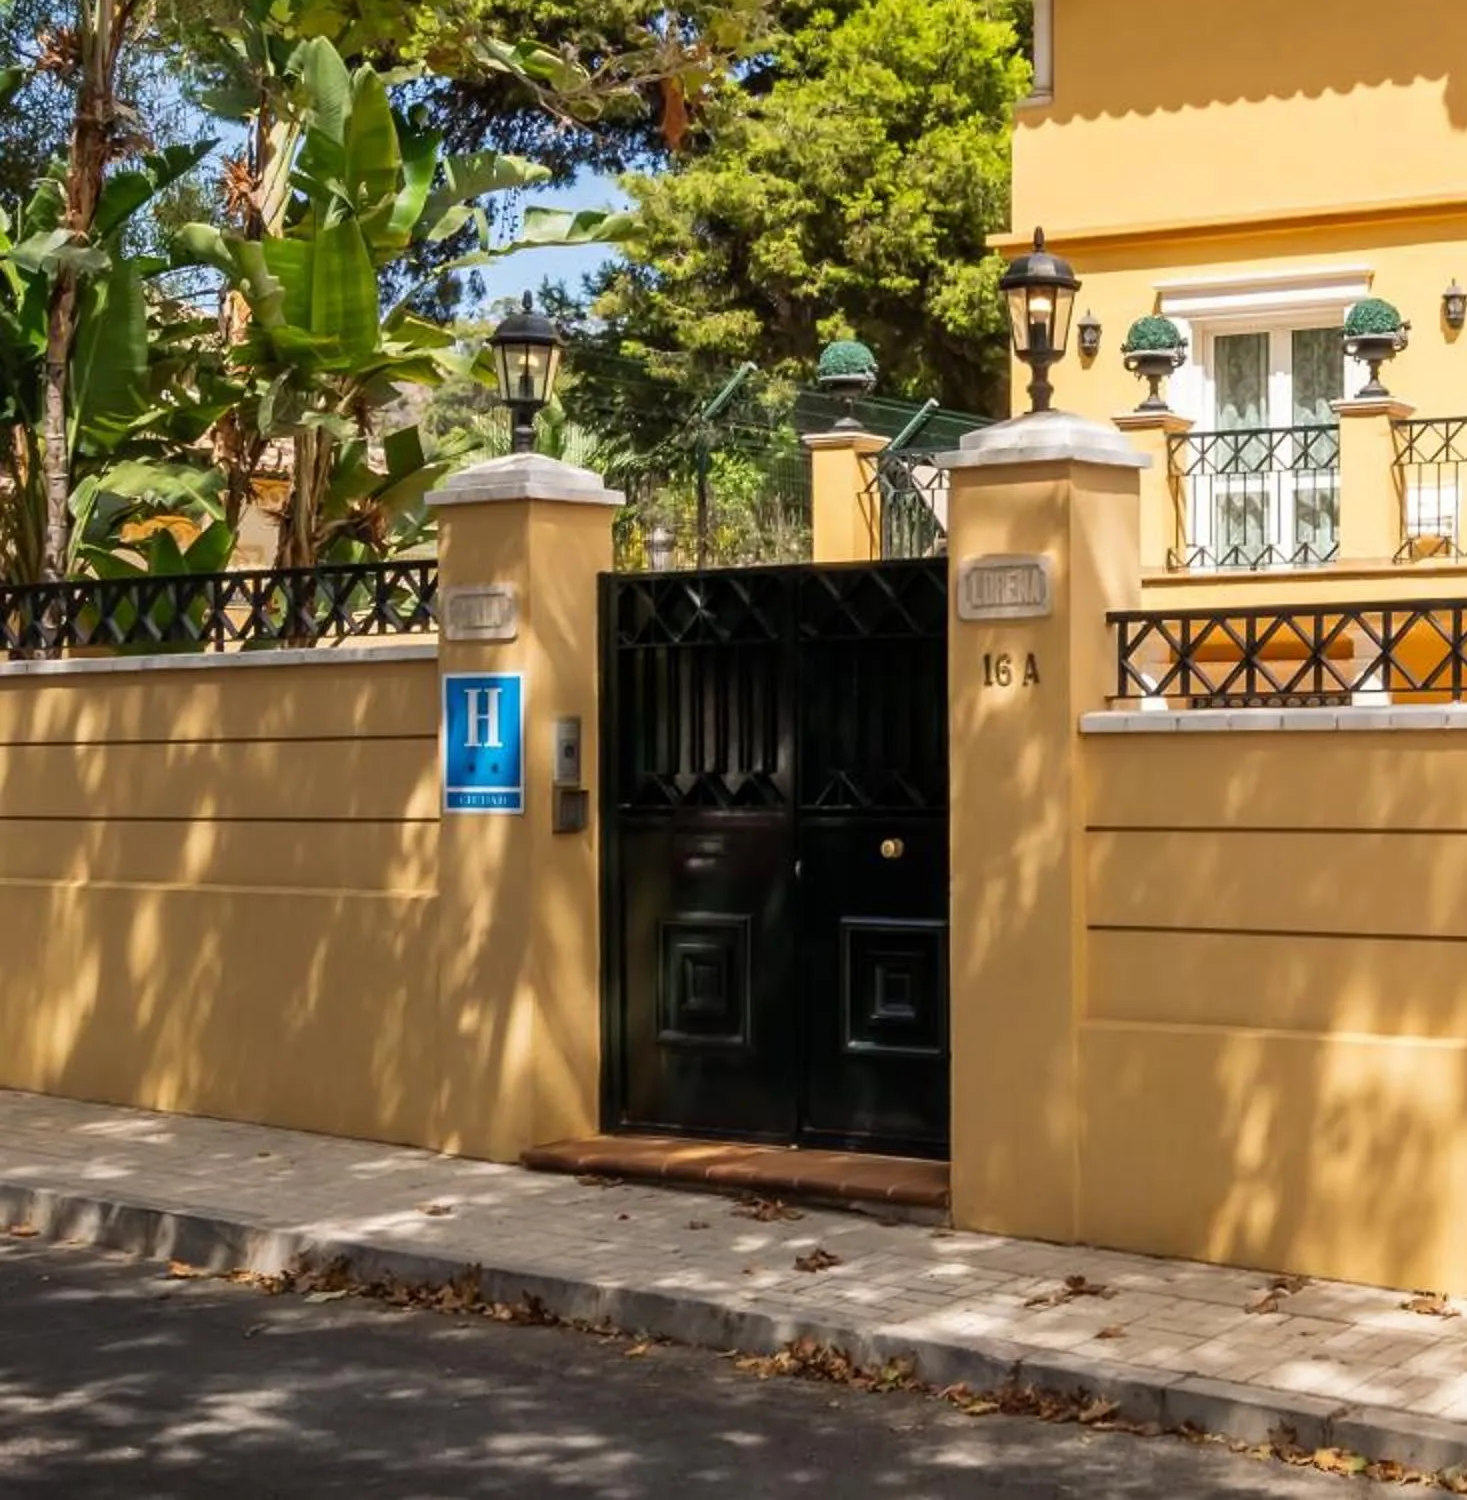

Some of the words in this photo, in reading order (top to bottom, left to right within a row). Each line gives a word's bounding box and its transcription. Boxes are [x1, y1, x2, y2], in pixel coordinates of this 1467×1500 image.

[983, 652, 1012, 687] 16
[1022, 651, 1040, 687] A
[463, 688, 503, 747] H
